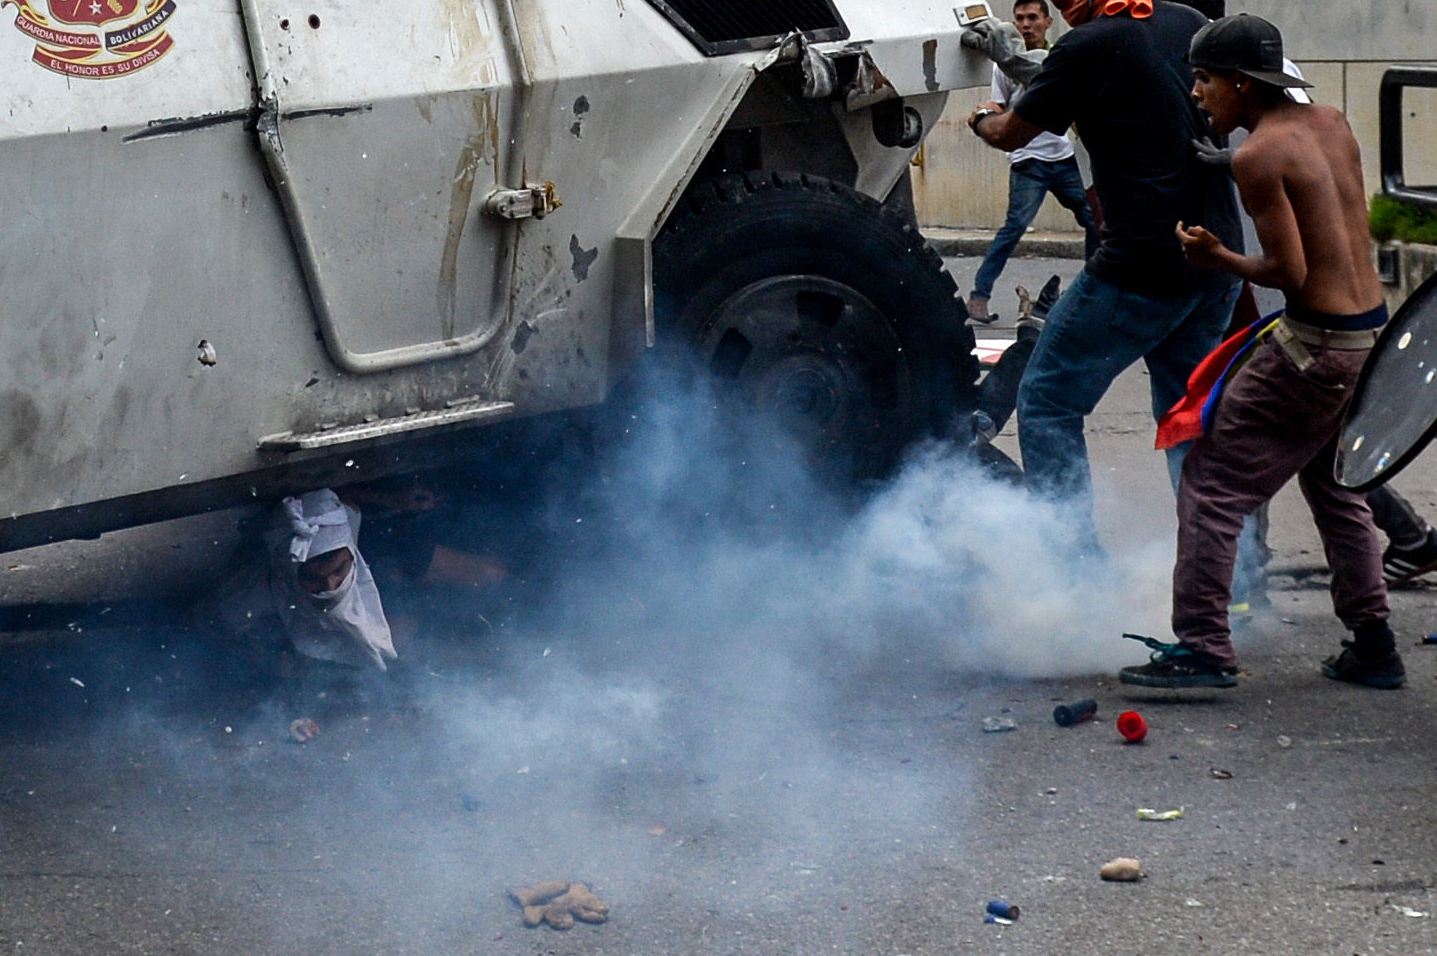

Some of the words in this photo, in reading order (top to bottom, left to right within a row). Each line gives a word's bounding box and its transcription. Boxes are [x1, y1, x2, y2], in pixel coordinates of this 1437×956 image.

[16, 16, 55, 41] GUARDIA
[55, 34, 101, 45] NACIONAL
[109, 9, 169, 45] BOLIVARIANA
[50, 59, 62, 69] EL
[65, 63, 99, 76] HONOR
[102, 63, 115, 75] ES
[118, 62, 131, 73] SU
[133, 48, 161, 68] DIVISA
